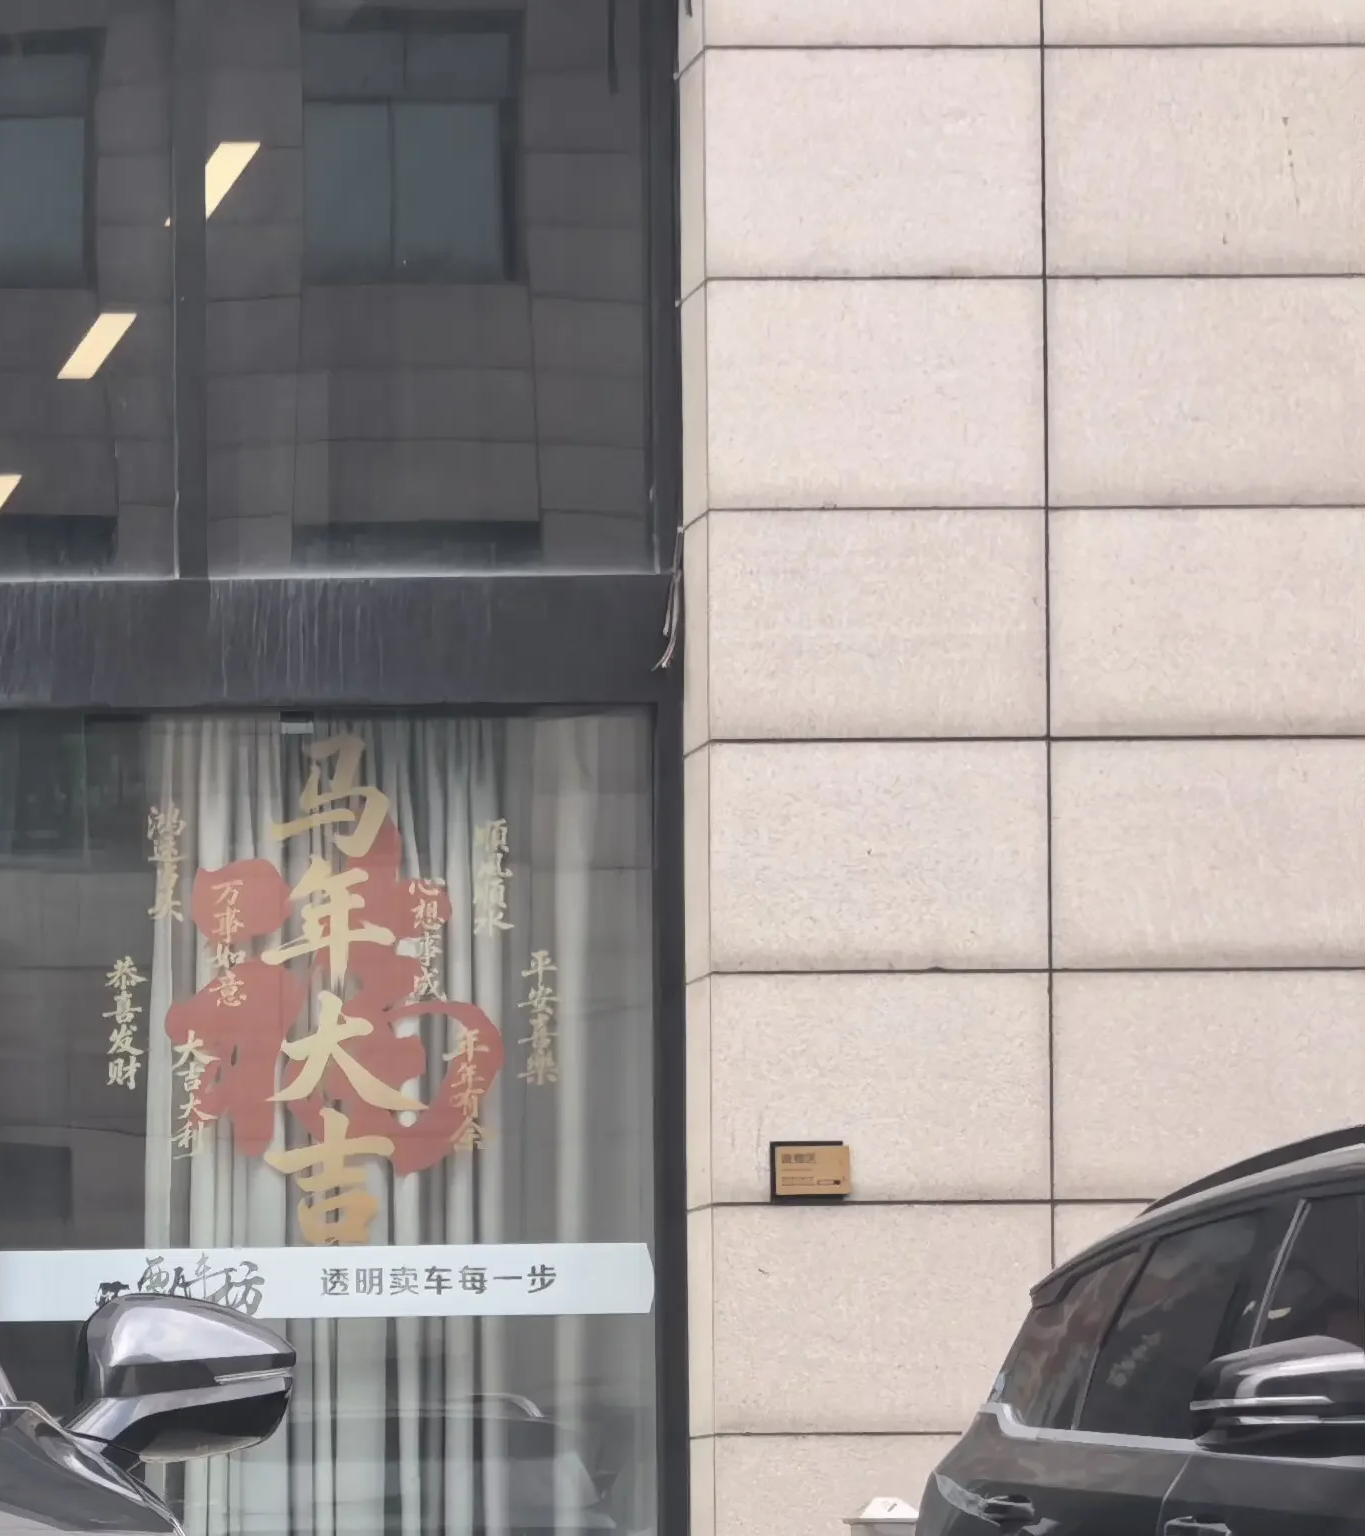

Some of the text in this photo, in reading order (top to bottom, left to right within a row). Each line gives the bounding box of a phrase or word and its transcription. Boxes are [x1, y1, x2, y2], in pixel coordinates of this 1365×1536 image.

[209, 879, 247, 1008] 万事如意
[262, 735, 429, 1246] 马年大吉
[408, 877, 448, 1003] 心想事成
[101, 956, 149, 1091] 恭喜发财
[169, 1029, 221, 1160] 大吉大利
[319, 1264, 557, 1295] 透明卖车每一步
